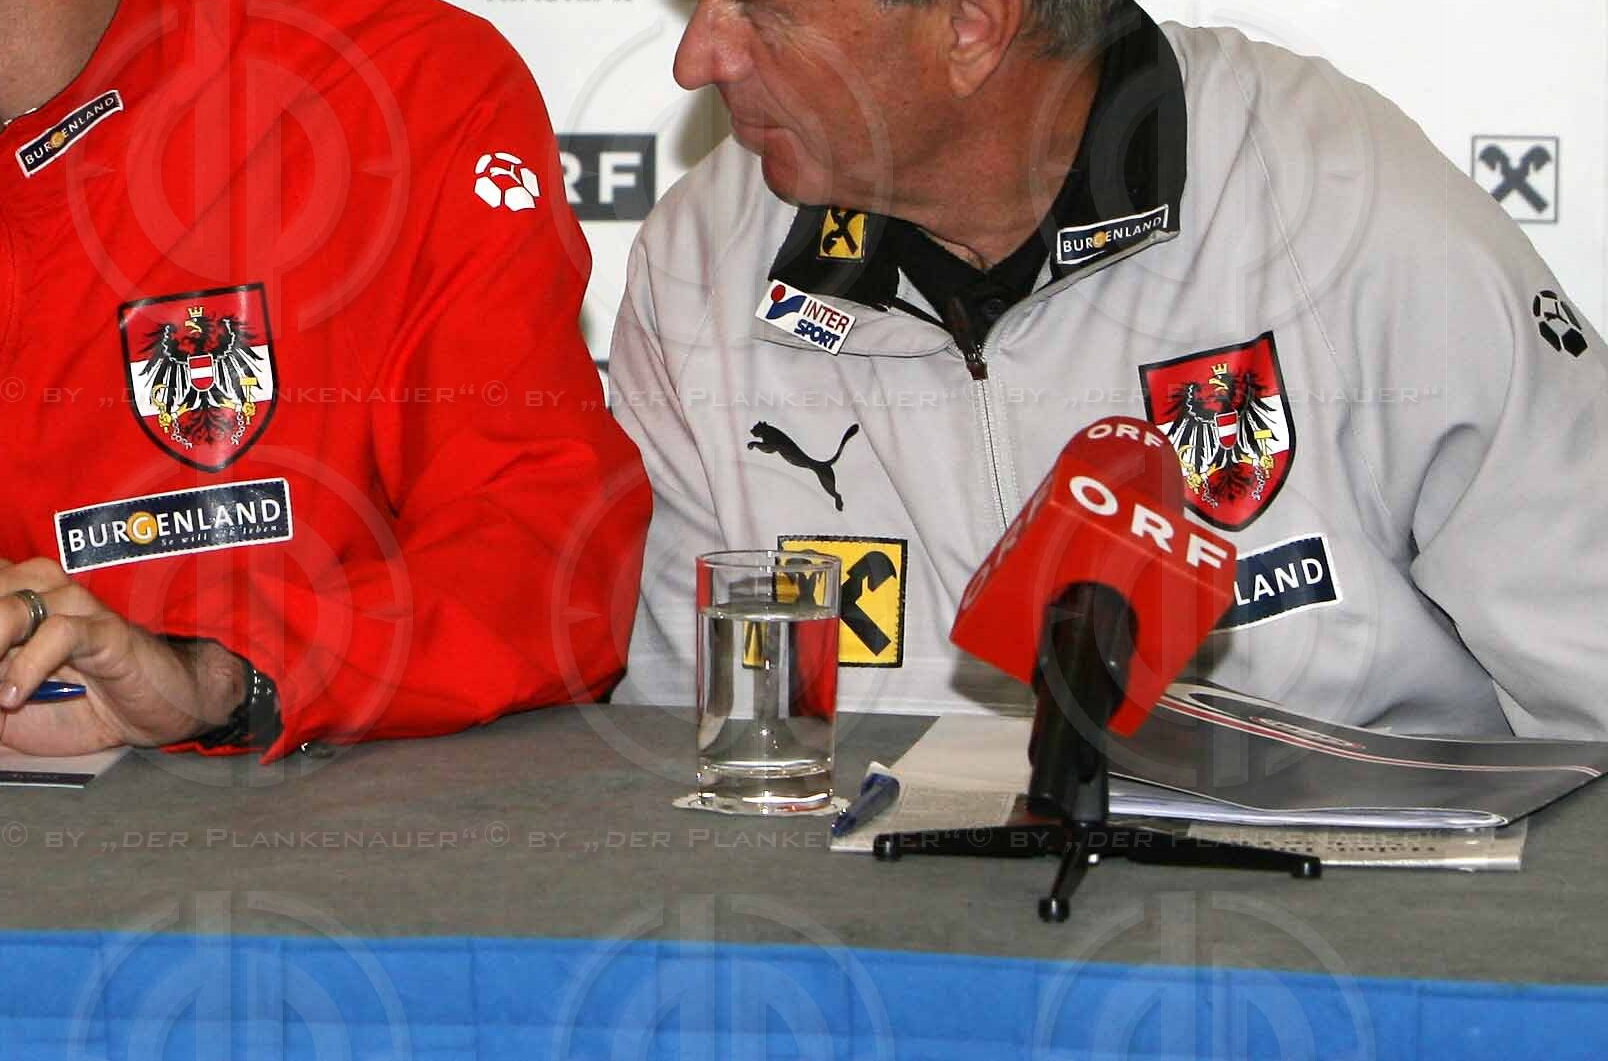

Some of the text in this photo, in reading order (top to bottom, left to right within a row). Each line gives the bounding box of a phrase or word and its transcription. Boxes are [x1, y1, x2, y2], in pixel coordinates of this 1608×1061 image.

[559, 151, 642, 204] RF
[794, 318, 841, 350] SPORT
[803, 299, 850, 334] INTER
[1086, 422, 1164, 448] ORF
[67, 497, 282, 553] BURGENLAND
[1069, 475, 1229, 570] ORF
